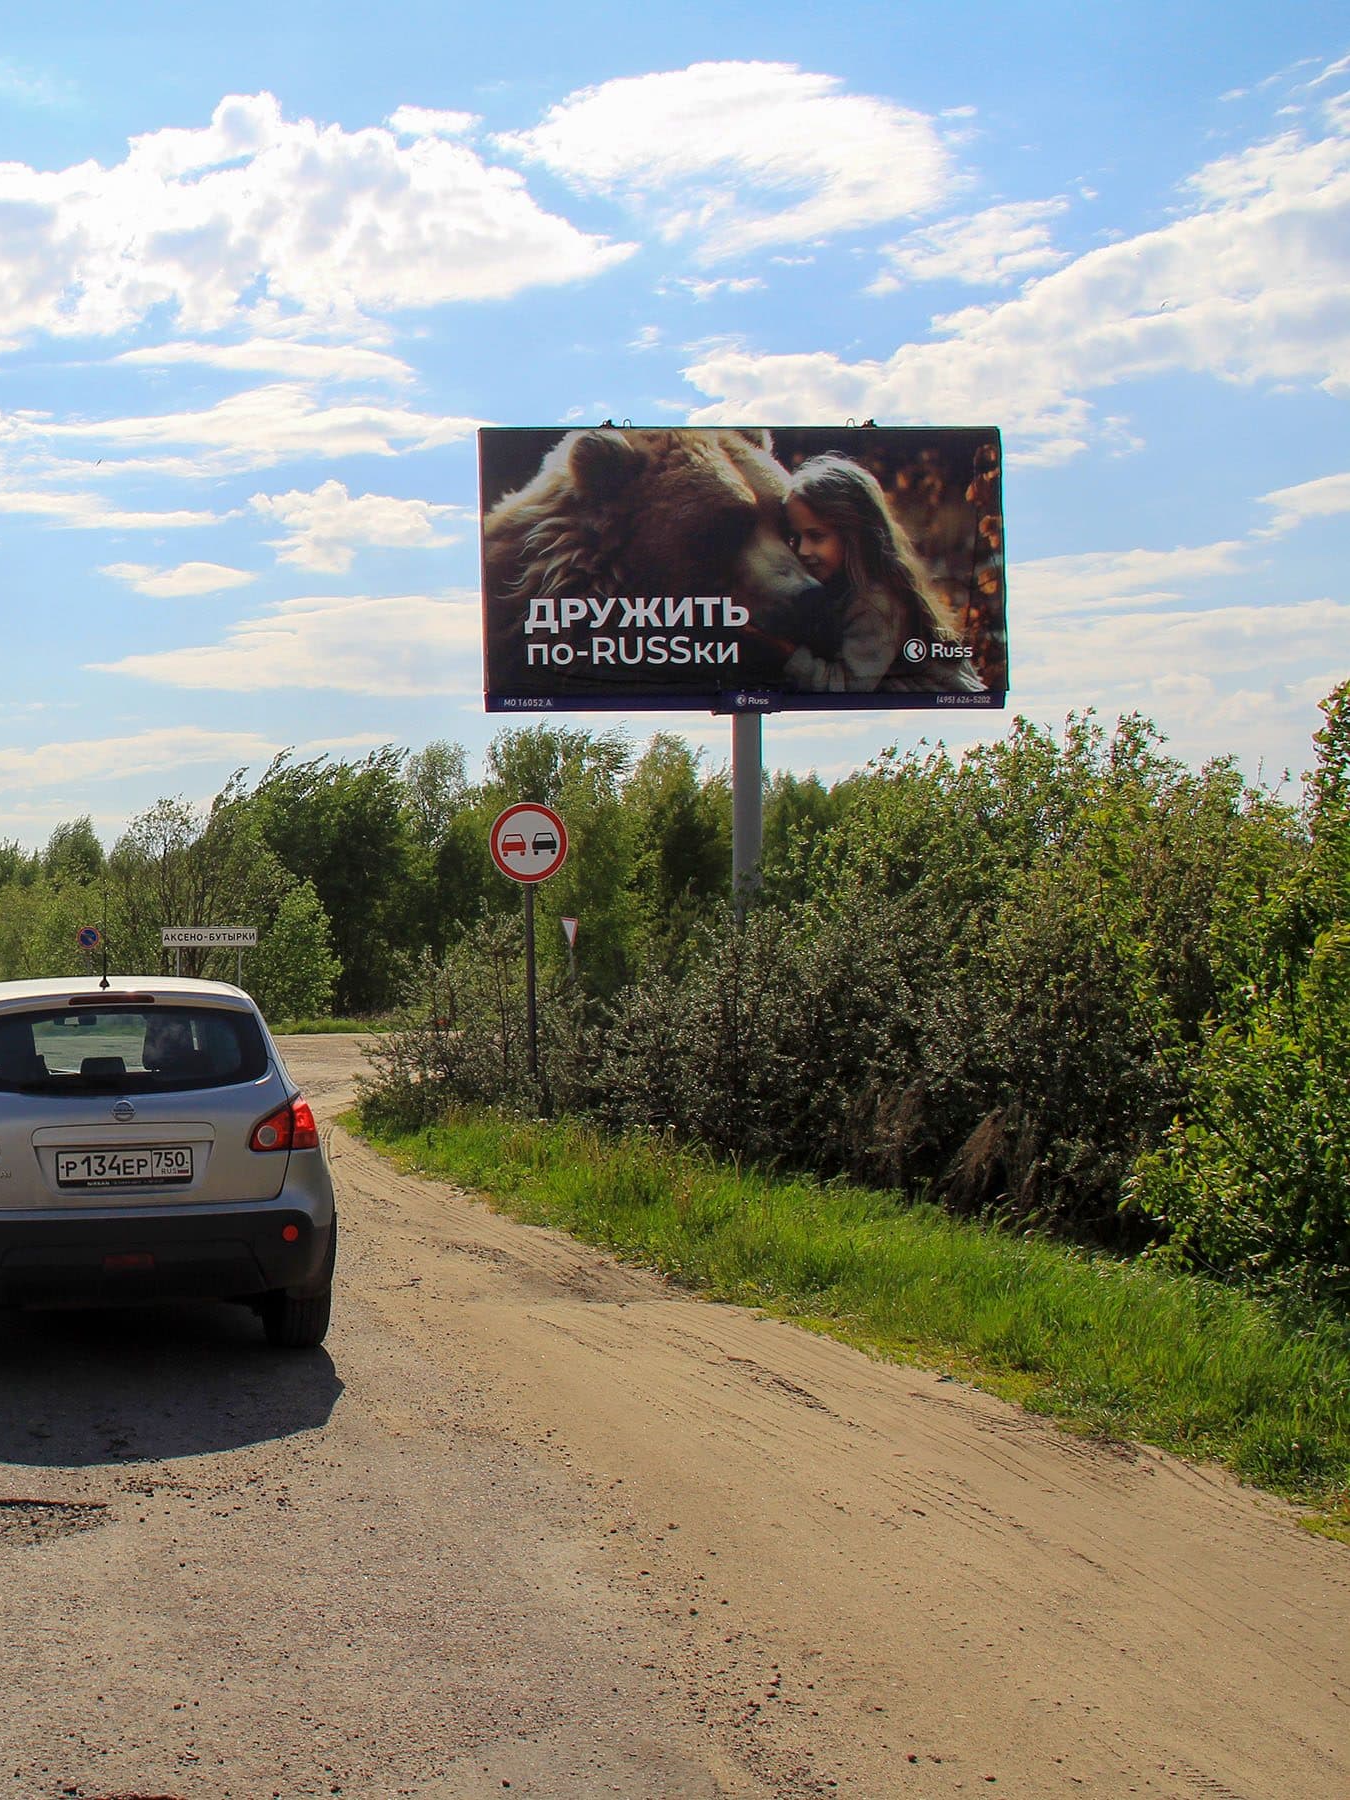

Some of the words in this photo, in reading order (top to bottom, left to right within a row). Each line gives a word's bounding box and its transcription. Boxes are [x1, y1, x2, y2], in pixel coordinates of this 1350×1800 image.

[524, 597, 750, 634] ДРУЖИТЬ
[527, 636, 739, 665] по-RUSSки
[931, 642, 974, 658] Russ
[518, 698, 544, 707] 16052
[748, 696, 770, 705] Russ
[164, 932, 255, 942] АКСЕНО-БУТЫРКИ
[65, 1154, 148, 1177] Р134ЕР
[153, 1151, 185, 1168] 750
[161, 1167, 178, 1175] RUS
